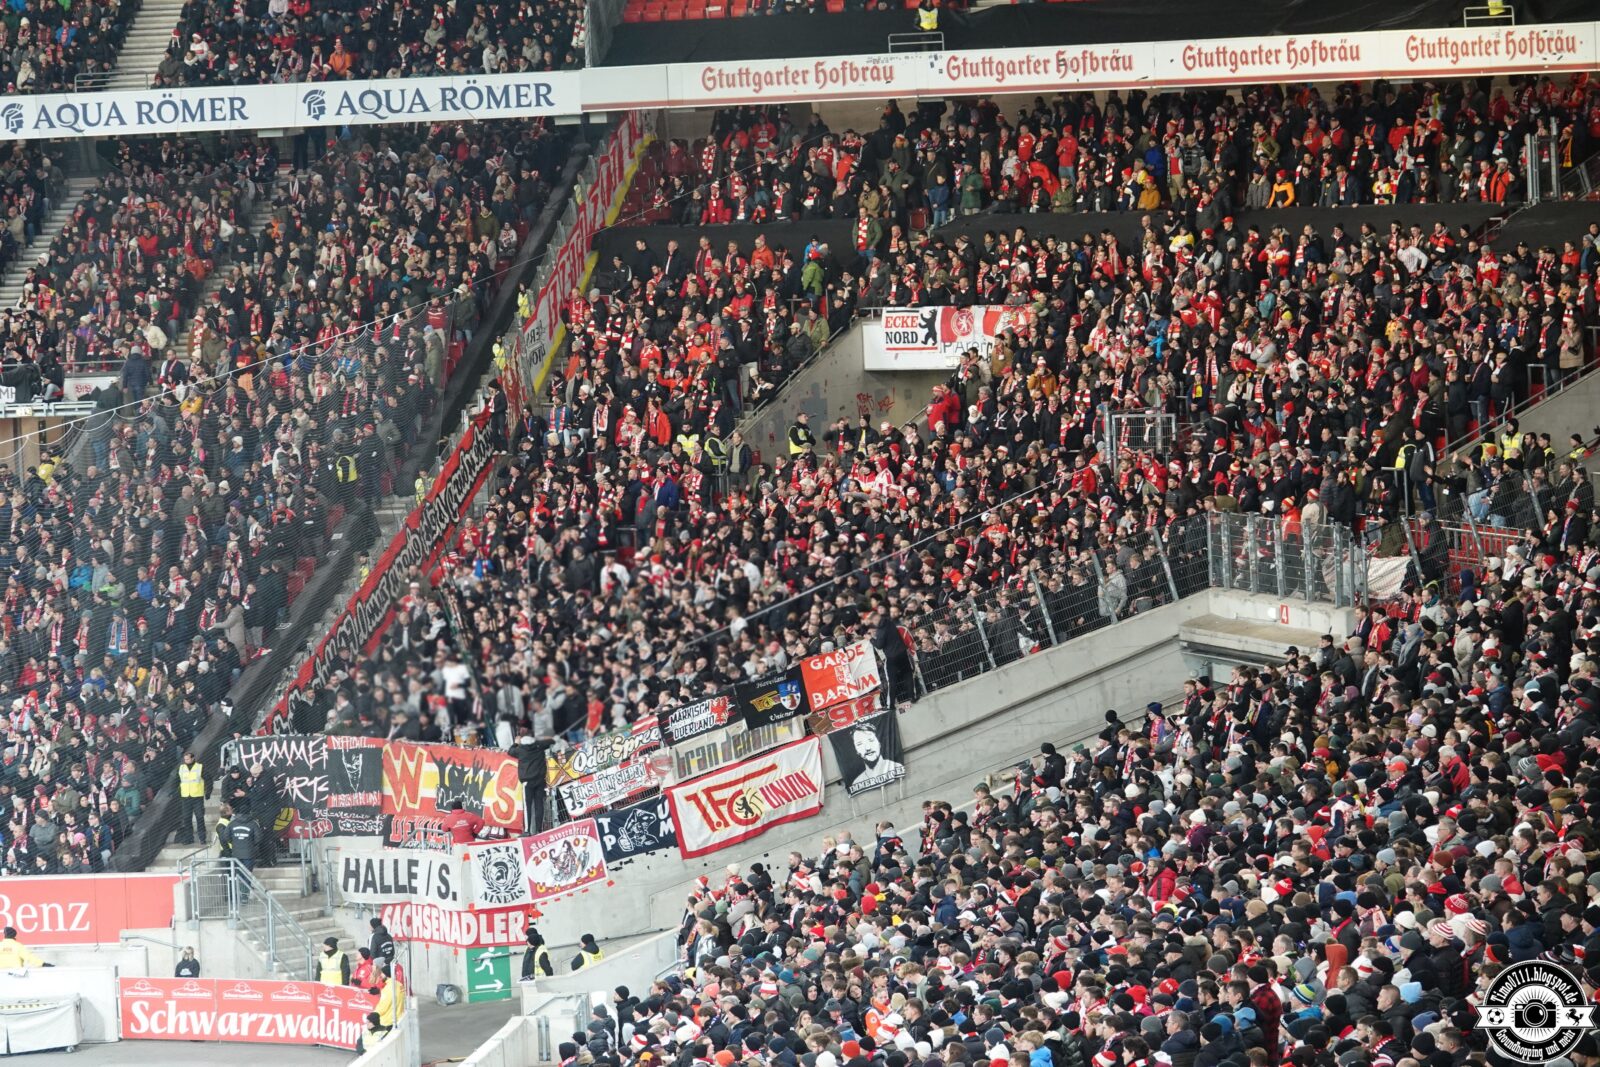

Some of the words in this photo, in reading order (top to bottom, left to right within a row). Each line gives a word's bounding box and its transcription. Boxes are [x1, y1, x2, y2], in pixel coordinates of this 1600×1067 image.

[1182, 44, 1282, 73] Stuttgarter
[1286, 38, 1361, 70] Hofbräu
[1405, 35, 1500, 65] Stuttgarter
[1504, 29, 1577, 60] Hofbräu
[701, 65, 810, 94] Stuttgarter
[814, 60, 895, 90] Hofbräu
[946, 54, 1050, 83] Stuttgarter
[1055, 48, 1134, 79] Hofbräu
[32, 101, 128, 133] AQUA
[136, 93, 250, 126] RÖMER
[334, 86, 432, 120] AQUA
[439, 79, 556, 112] RÖMER
[884, 315, 919, 329] ECKE
[885, 331, 919, 344] NORD
[1281, 605, 1288, 623] 4
[809, 643, 865, 671] GARDE
[811, 673, 877, 709] BARNIM
[669, 700, 711, 726] MÄRKISCH
[573, 746, 612, 773] Oder
[611, 726, 660, 761] Spree
[759, 770, 819, 810] UNION
[342, 857, 419, 895] HALLE
[0, 894, 91, 933] Benz
[480, 889, 526, 904] NINERS
[381, 904, 527, 946] SACHSENADLER
